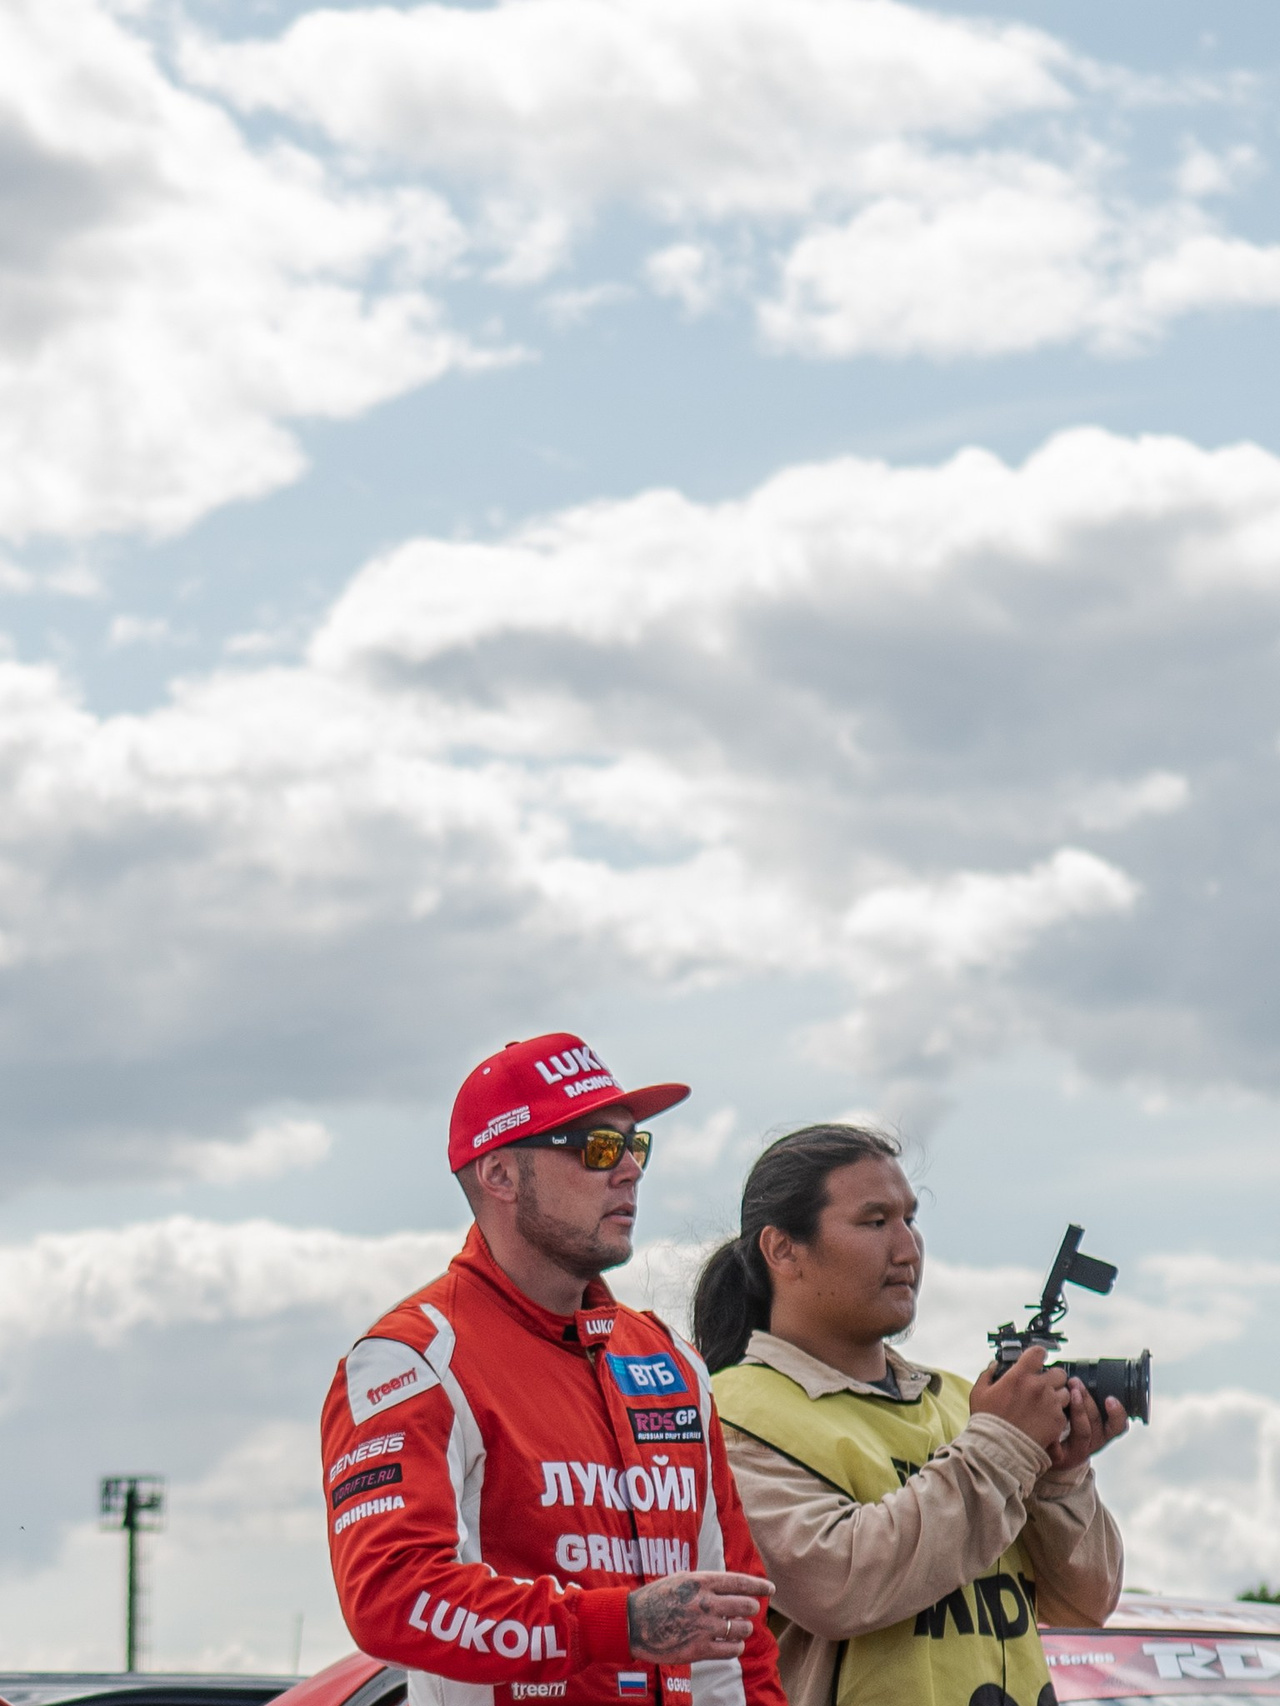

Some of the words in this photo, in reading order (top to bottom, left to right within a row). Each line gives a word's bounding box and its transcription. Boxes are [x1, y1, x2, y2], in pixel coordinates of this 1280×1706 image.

[564, 1075, 613, 1098] RACING
[473, 1110, 531, 1148] GENESIS
[366, 1368, 418, 1406] freem
[628, 1362, 675, 1388] ВТБ
[635, 1412, 676, 1431] RDS
[676, 1409, 697, 1425] GP
[329, 1436, 405, 1484] GENESIS
[541, 1454, 697, 1512] ЛУКОЙЛ
[408, 1590, 567, 1662] LUKOIL
